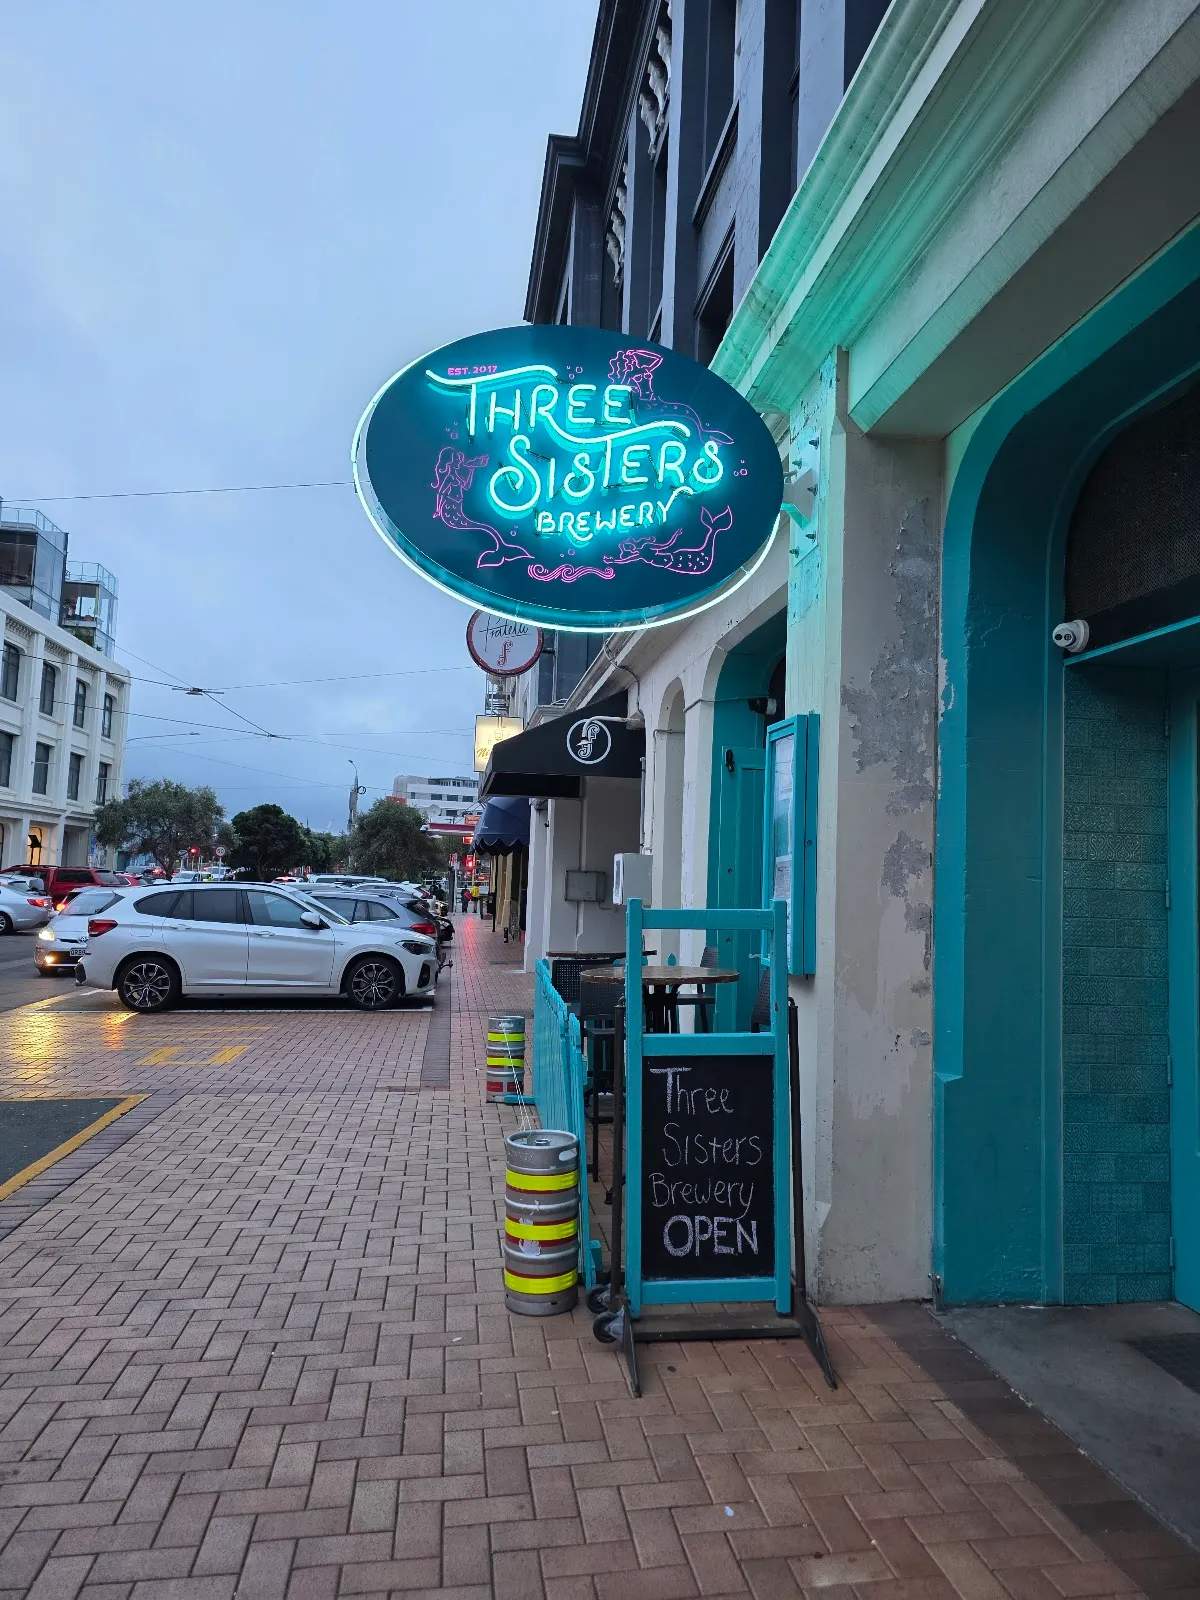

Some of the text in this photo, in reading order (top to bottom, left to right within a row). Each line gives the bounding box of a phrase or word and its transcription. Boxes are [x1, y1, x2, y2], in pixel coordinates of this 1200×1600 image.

[447, 364, 498, 376] EST. 2017
[426, 364, 634, 436] THREE
[489, 420, 724, 512] SISTERS
[537, 486, 692, 542] BREWERY
[650, 1066, 735, 1116] Three
[662, 1122, 763, 1167] Sisters
[649, 1172, 755, 1222] Brewery
[663, 1214, 760, 1257] OPEN
